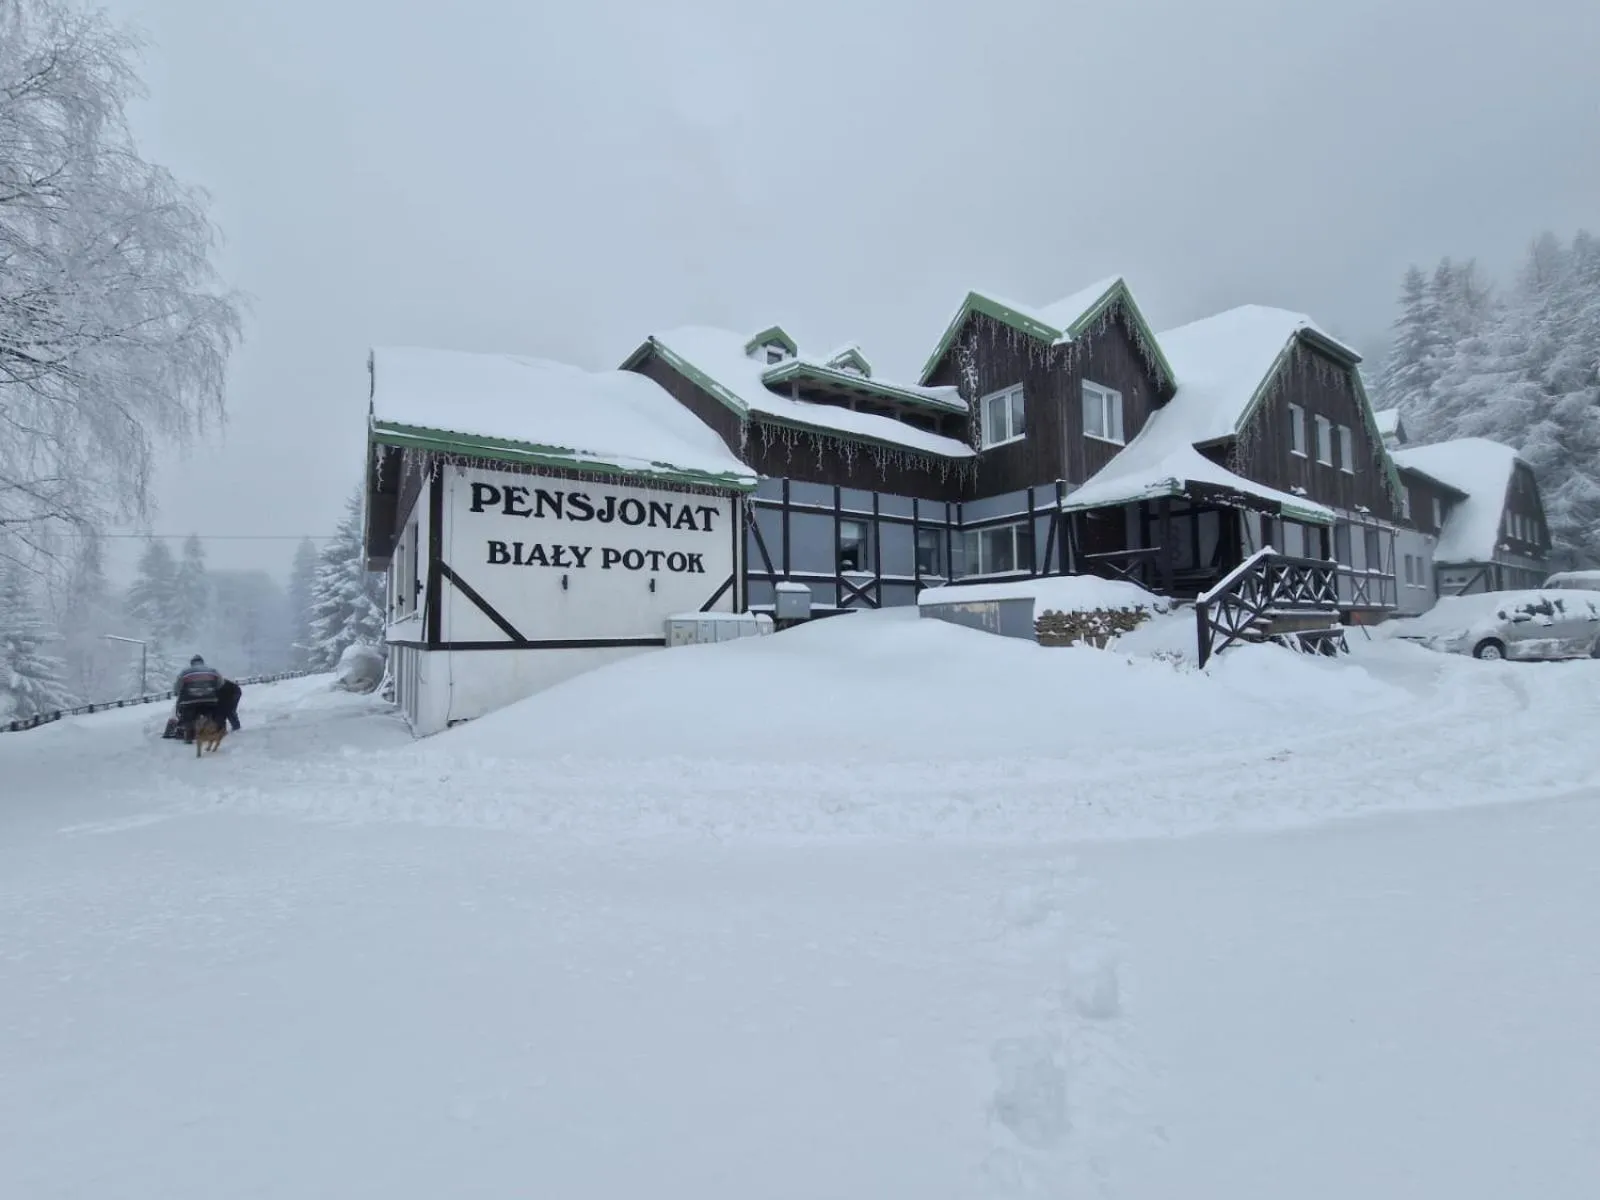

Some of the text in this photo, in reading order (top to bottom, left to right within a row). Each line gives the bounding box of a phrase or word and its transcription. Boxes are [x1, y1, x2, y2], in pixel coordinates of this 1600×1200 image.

[470, 482, 719, 531] PENSJONAT
[487, 540, 705, 573] BIAŁY POTOK
